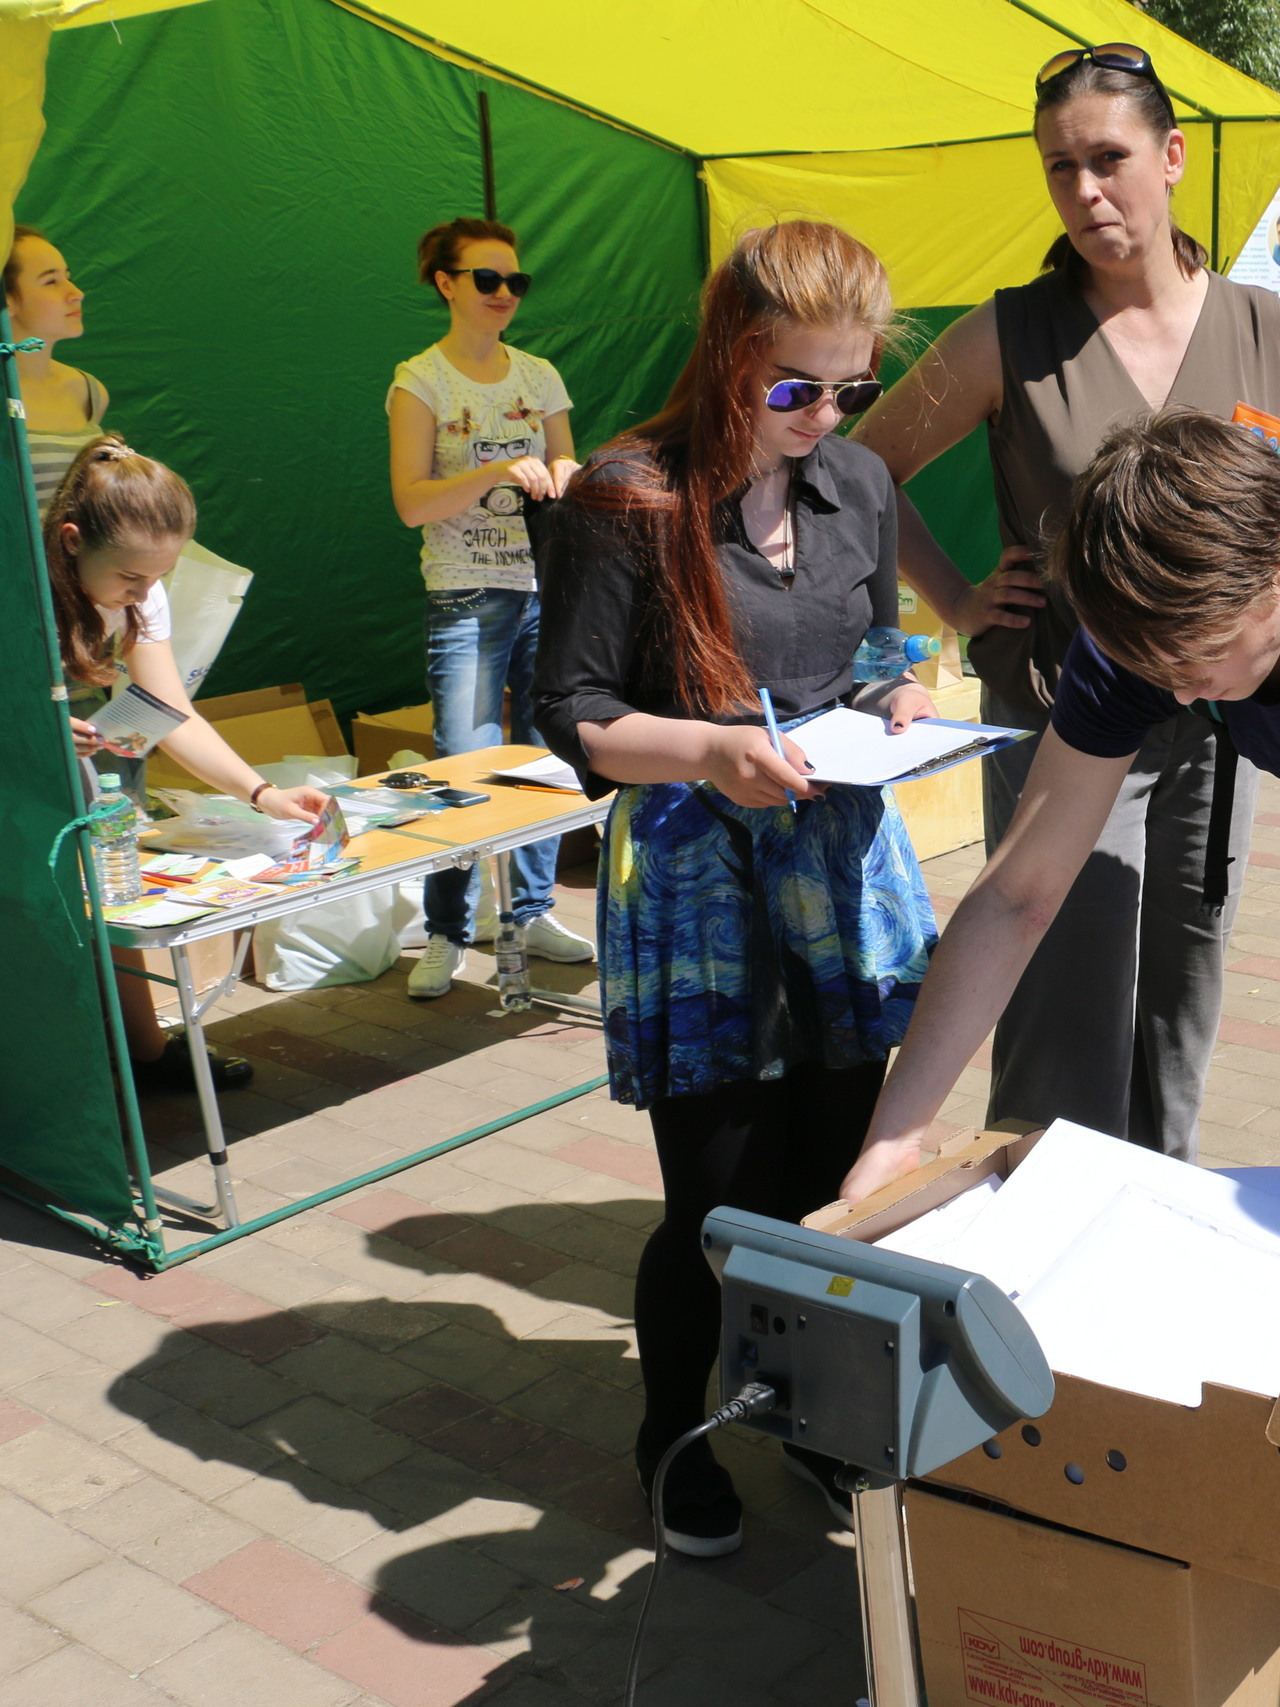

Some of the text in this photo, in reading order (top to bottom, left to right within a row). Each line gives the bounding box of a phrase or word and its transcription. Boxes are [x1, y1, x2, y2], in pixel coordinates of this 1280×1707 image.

[463, 527, 507, 547] CATCH
[471, 547, 534, 566] THE MOMEN
[968, 1637, 997, 1653] KDV
[1019, 1635, 1142, 1689] www.kdv-group.com
